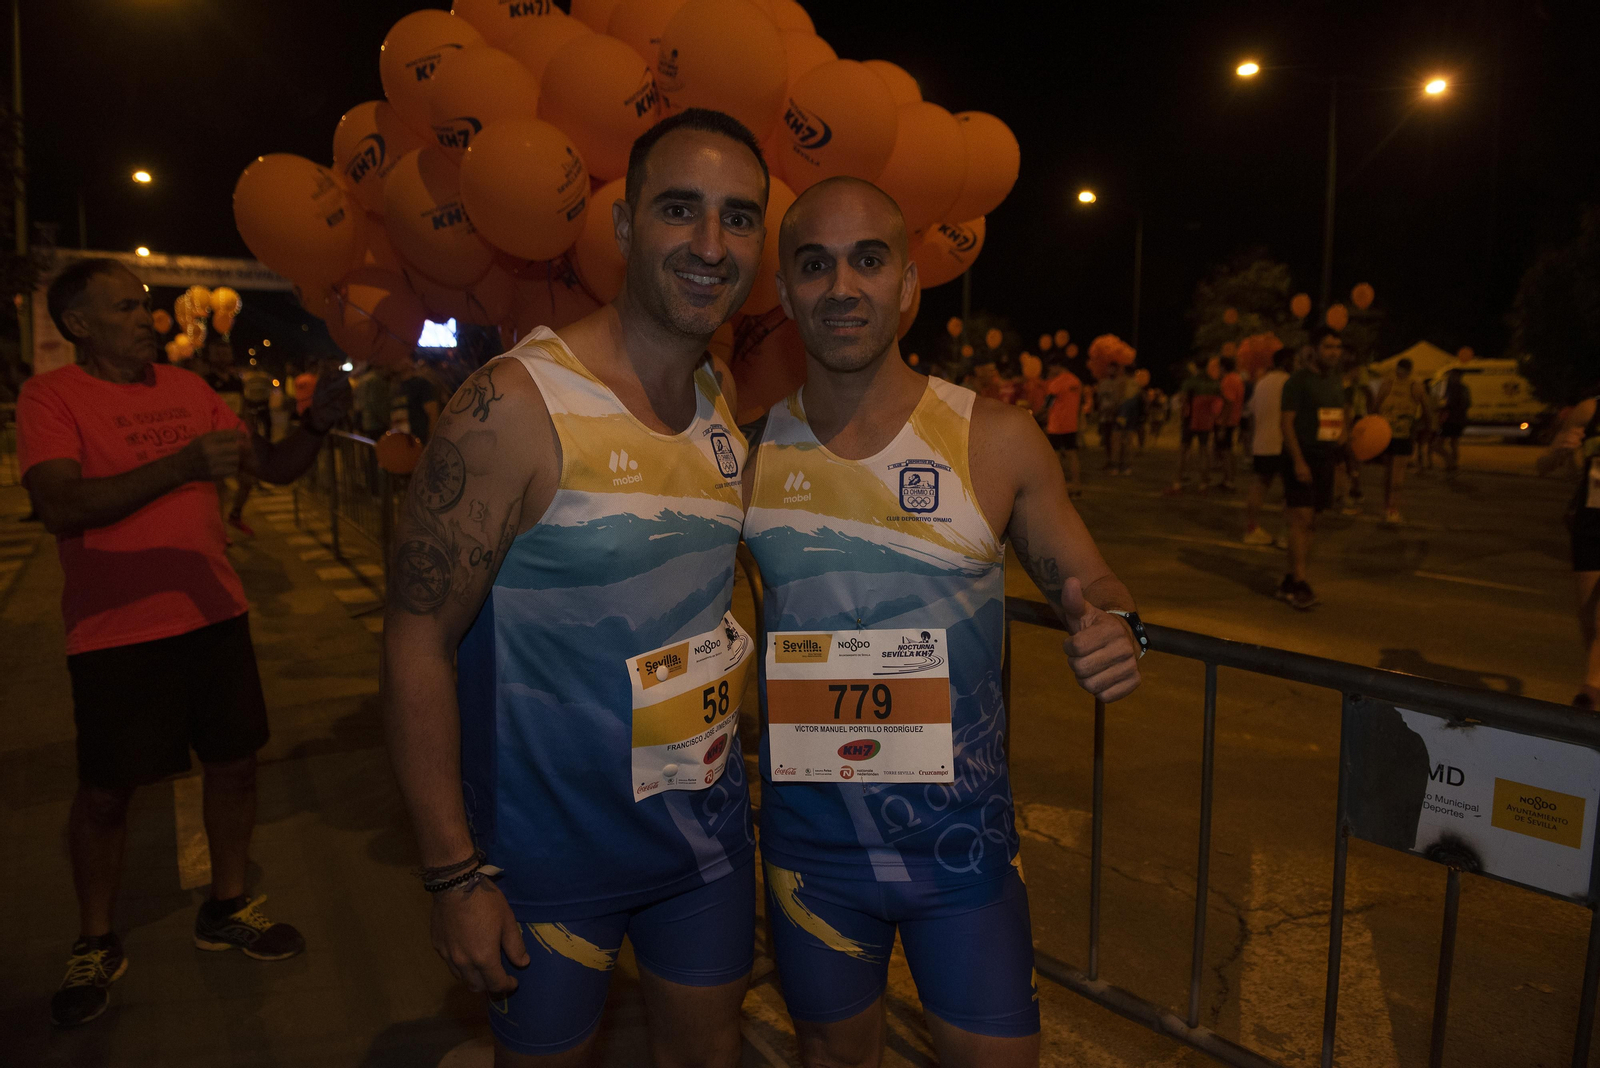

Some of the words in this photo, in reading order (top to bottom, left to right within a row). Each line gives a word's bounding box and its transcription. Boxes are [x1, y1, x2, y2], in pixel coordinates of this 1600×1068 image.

[612, 472, 643, 487] mobel
[783, 493, 812, 504] mobel
[469, 546, 493, 570] 04
[881, 650, 915, 658] SEVILLA
[703, 680, 730, 724] 58
[828, 683, 892, 720] 779
[795, 725, 819, 733] VÍCTOR
[820, 725, 848, 733] MANUEL
[849, 725, 882, 733] PORTILLO
[883, 724, 924, 733] RODRÍGUEZ
[666, 735, 704, 751] FRANCISCO
[918, 769, 949, 777] Cruzcampo
[923, 730, 1005, 812] OHMIO
[1423, 802, 1465, 819] Deportes
[1434, 794, 1480, 813] Municipal
[1506, 803, 1569, 826] AYUNTAMIENTO
[1514, 814, 1526, 823] DE
[1526, 816, 1558, 831] SEVILLA
